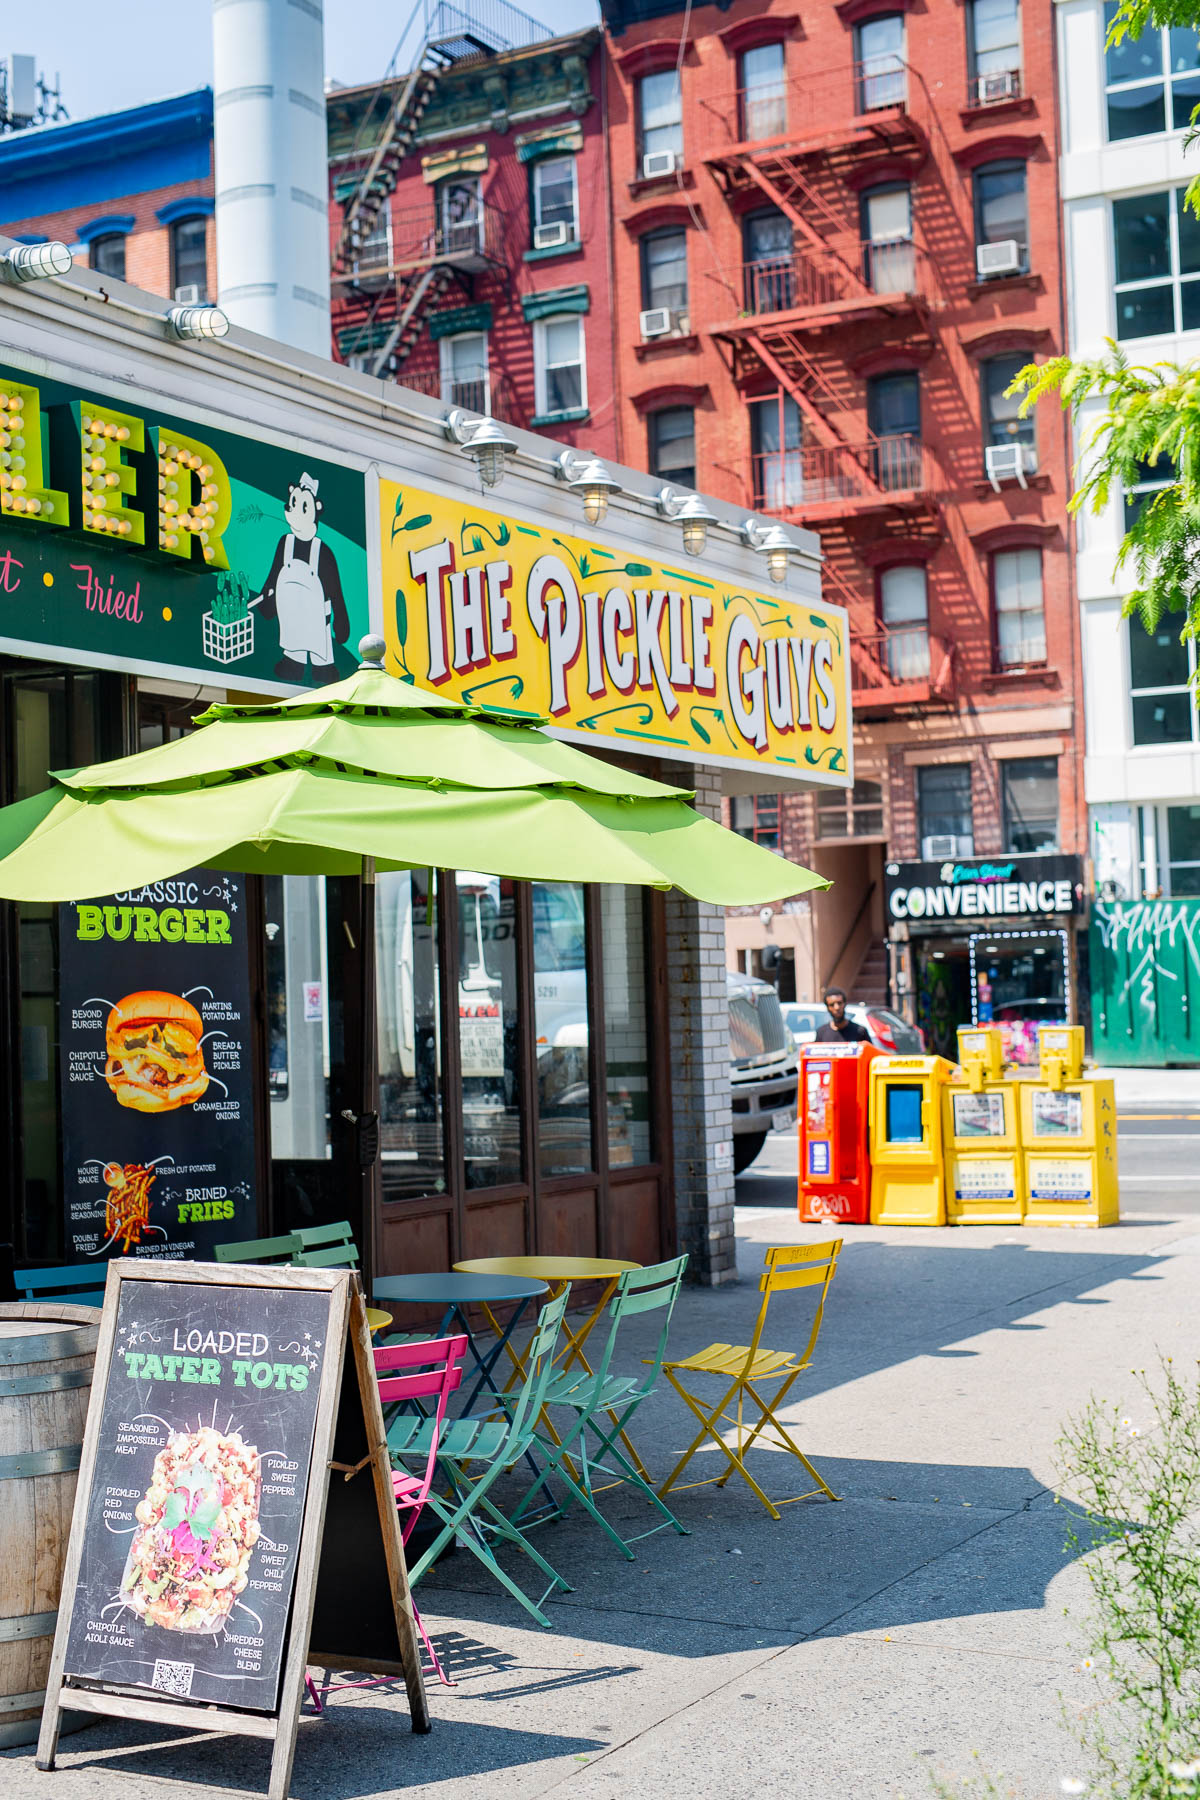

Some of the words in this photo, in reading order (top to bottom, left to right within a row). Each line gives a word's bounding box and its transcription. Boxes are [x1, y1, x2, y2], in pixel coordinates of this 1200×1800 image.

[69, 563, 144, 624] Fried
[408, 537, 518, 687] THE
[526, 555, 716, 720] PICKLE
[725, 613, 837, 755] GUYS
[890, 880, 1073, 918] CONVENIENCE
[76, 905, 232, 944] BURGER
[202, 1002, 232, 1010] MARTINS
[72, 1010, 102, 1018] BEYOND
[202, 1012, 226, 1020] POTATO
[226, 1012, 240, 1020] BUN
[72, 1020, 102, 1029] BURGER
[212, 1042, 236, 1050] BREAD
[236, 1042, 242, 1050] &
[69, 1052, 106, 1060] CHIPOTLE
[213, 1052, 240, 1060] BUTTER
[70, 1062, 92, 1071] AIOLI
[214, 1062, 240, 1070] PICKLES
[70, 1072, 94, 1082] SAUCE
[193, 1102, 240, 1112] CARAMELIZED
[216, 1112, 240, 1120] ONIONS
[78, 1166, 100, 1175] HOUSE
[156, 1168, 175, 1176] FRESH
[176, 1166, 188, 1174] CUT
[190, 1164, 216, 1172] POTATOES
[78, 1176, 100, 1184] SAUCE
[186, 1186, 227, 1202] BRINED
[70, 1202, 92, 1210] HOUSE
[178, 1200, 234, 1223] FRIES
[70, 1210, 106, 1220] SEASONING
[73, 1234, 99, 1243] DOUBLE
[76, 1242, 96, 1252] FRIED
[136, 1245, 160, 1254] BRINED
[160, 1244, 168, 1252] IN
[168, 1242, 195, 1250] VINEGAR
[164, 1251, 184, 1260] SUGAR
[174, 1328, 268, 1356] LOADED
[124, 1352, 222, 1385] TATER
[232, 1360, 310, 1392] TOTS
[118, 1422, 160, 1434] SEASONED
[116, 1434, 166, 1446] IMPOSSIBLE
[114, 1445, 138, 1455] MEAT
[267, 1458, 299, 1470] PICKLED
[270, 1472, 297, 1483] SWEET
[106, 1486, 140, 1498] PICKLED
[262, 1484, 296, 1496] PEPPERS
[104, 1498, 122, 1508] RED
[102, 1510, 132, 1520] ONIONS
[257, 1541, 289, 1552] PICKLED
[260, 1554, 287, 1566] SWEET
[264, 1568, 284, 1579] CHILI
[249, 1580, 282, 1592] PEPPERS
[86, 1620, 126, 1634] CHIPOTLE
[84, 1632, 108, 1644] AIOLI
[108, 1635, 134, 1648] SAUCE
[224, 1633, 264, 1646] SHREDDED
[234, 1647, 262, 1660] CHEESE
[236, 1660, 260, 1672] BLEND
